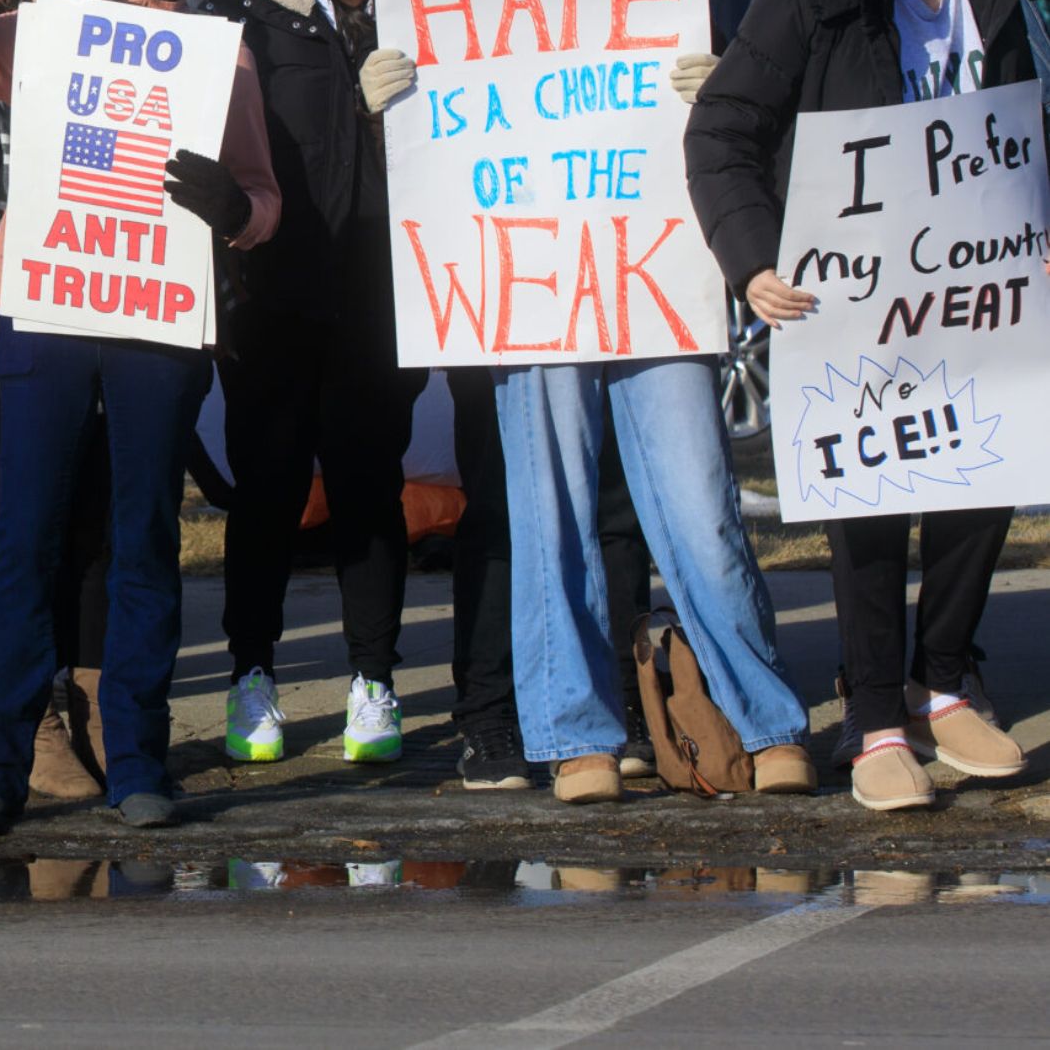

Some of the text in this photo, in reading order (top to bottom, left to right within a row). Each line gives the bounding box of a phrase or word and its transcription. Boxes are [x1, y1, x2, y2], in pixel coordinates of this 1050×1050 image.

[77, 13, 183, 73] PRO
[67, 71, 173, 132] USA
[427, 61, 661, 139] IS A CHOICE
[472, 148, 648, 209] OF THE
[838, 112, 1031, 219] I Prefer
[42, 209, 168, 266] ANTI
[21, 258, 196, 324] TRUMP
[401, 214, 700, 356] WEAK
[877, 276, 1030, 346] NEAT
[853, 379, 918, 420] No
[814, 402, 962, 480] ICE!!
